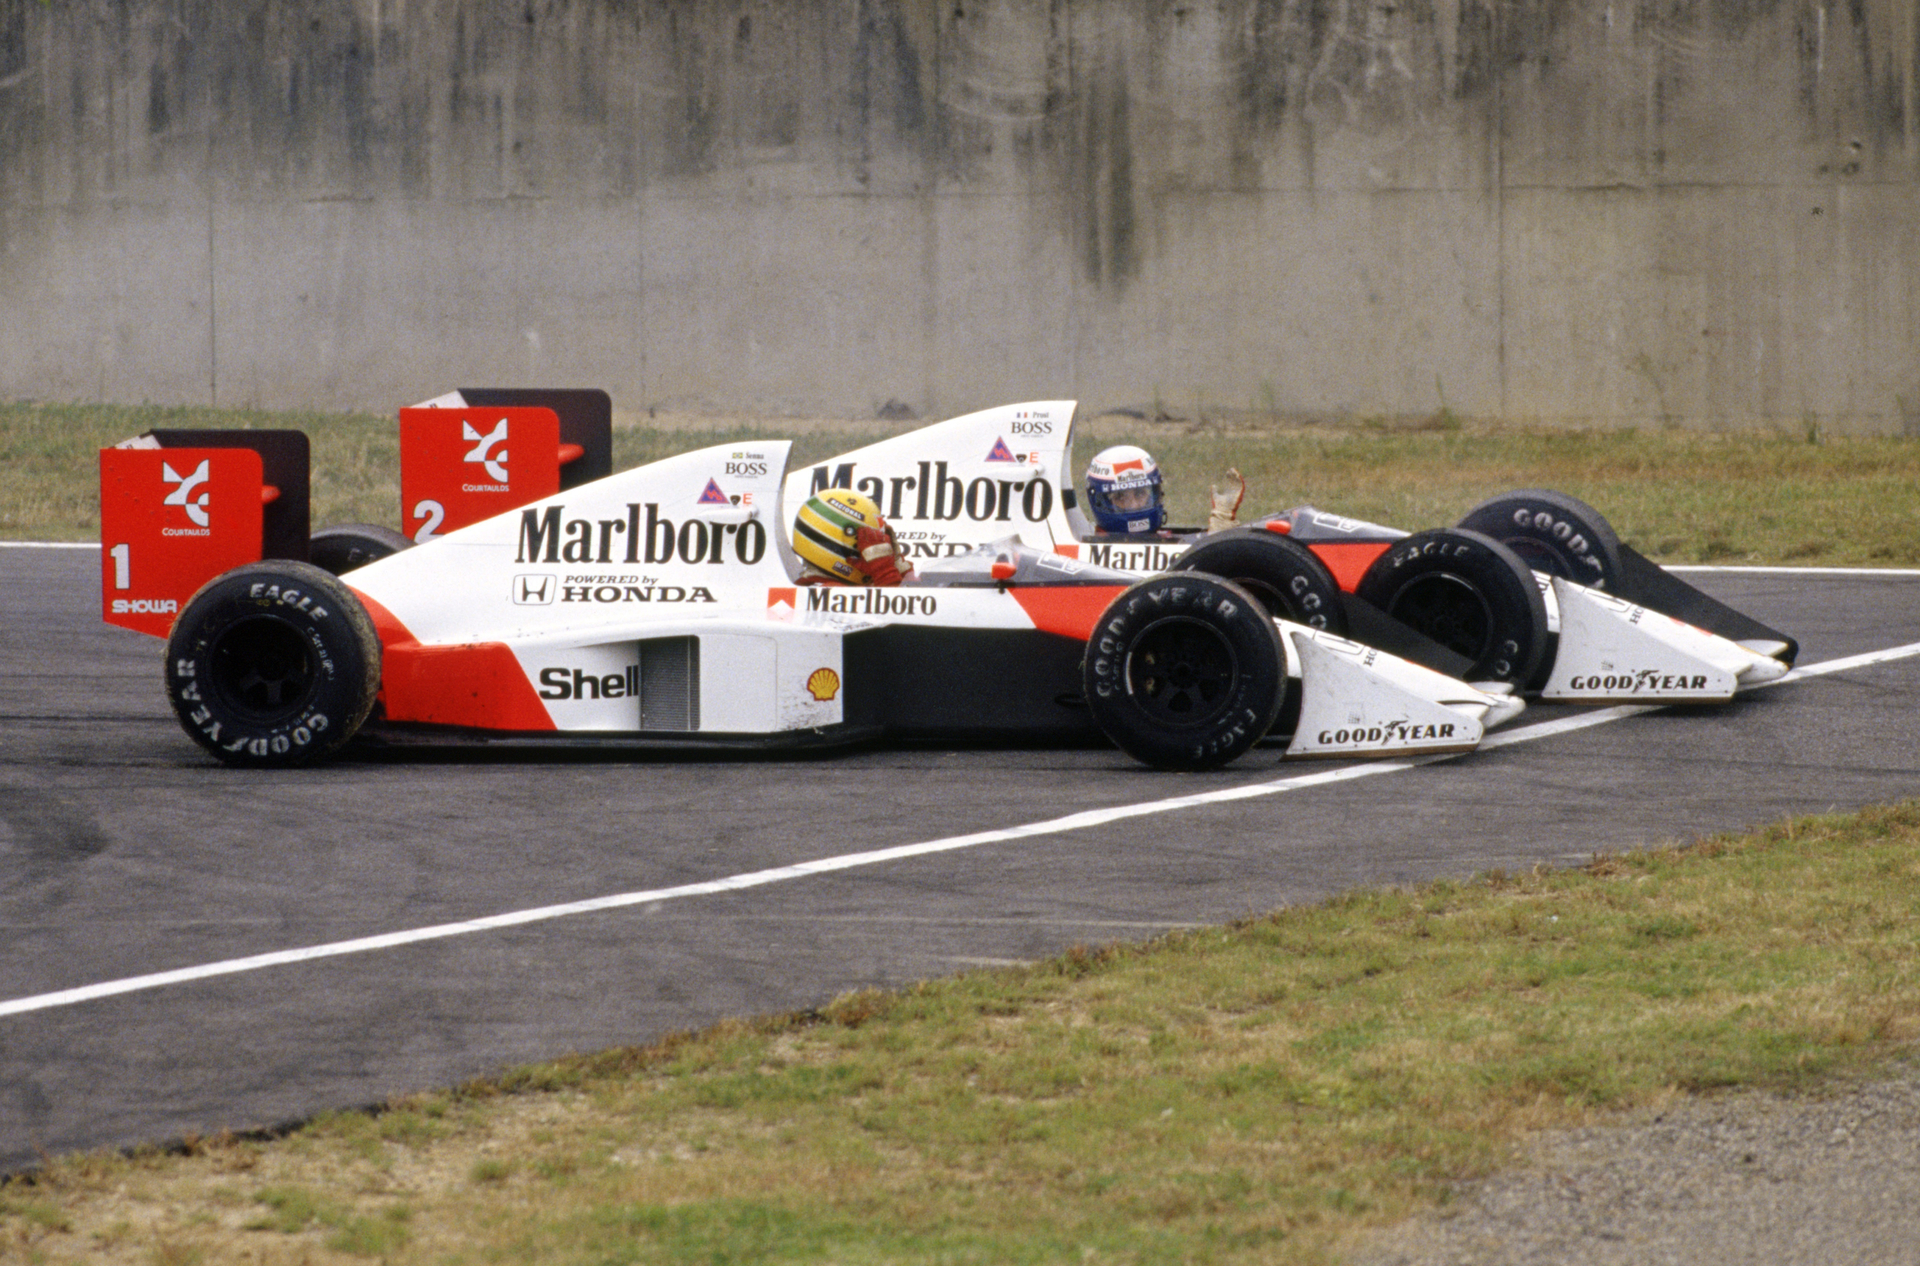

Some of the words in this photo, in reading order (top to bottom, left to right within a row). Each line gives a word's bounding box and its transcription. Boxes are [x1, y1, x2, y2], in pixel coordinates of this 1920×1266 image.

[1011, 422, 1052, 434] BOSS
[725, 462, 768, 475] BOSS
[810, 462, 1053, 523] Marlboro
[1111, 480, 1152, 491] HONDA
[831, 499, 862, 519] NACIONAL
[413, 499, 446, 545] 2
[514, 503, 766, 565] Marlboro
[930, 532, 946, 542] by
[110, 543, 130, 590] 1
[564, 575, 639, 584] POWERED
[642, 575, 659, 585] by
[250, 583, 329, 621] EAGLE
[561, 586, 718, 603] HONDA
[806, 588, 937, 616] Marlboro
[112, 599, 177, 613] SHOWA
[539, 665, 639, 700] Shell
